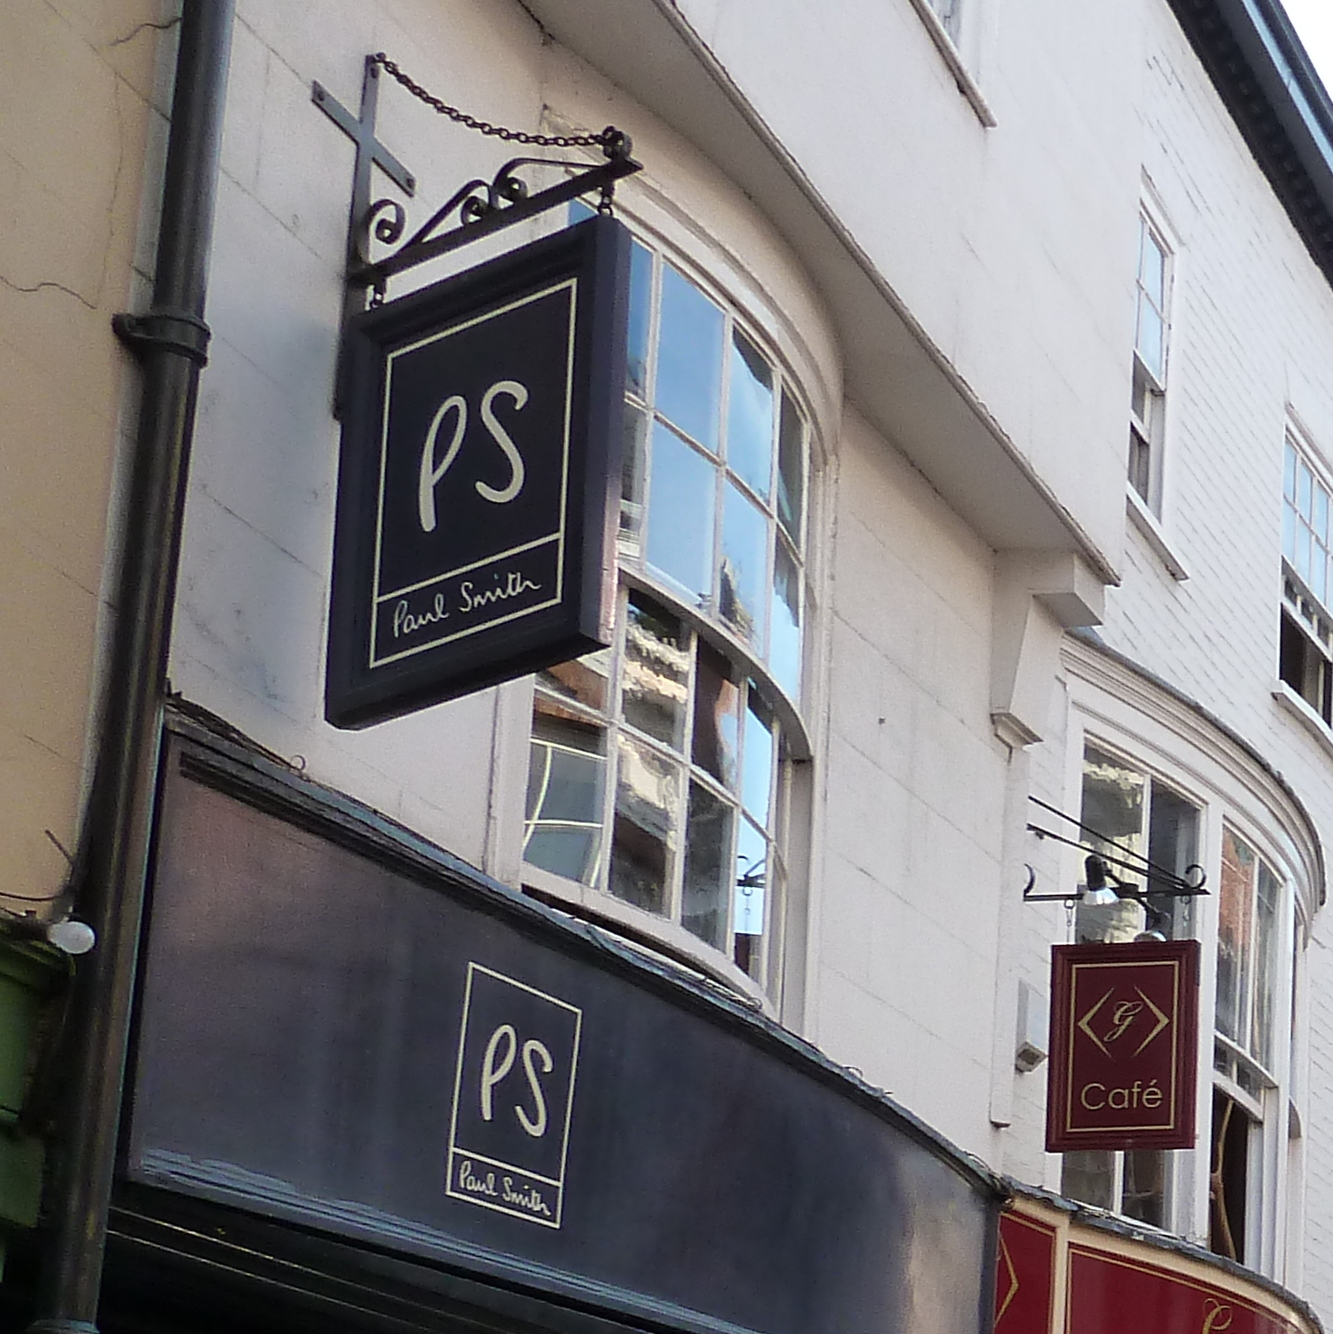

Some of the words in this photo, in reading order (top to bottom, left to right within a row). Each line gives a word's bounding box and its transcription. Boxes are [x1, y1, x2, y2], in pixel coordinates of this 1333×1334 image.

[419, 380, 528, 532] PS
[393, 593, 449, 637] Paul
[459, 572, 542, 612] Smith
[481, 1025, 553, 1137] PS
[1081, 1079, 1163, 1110] Café
[459, 1160, 499, 1196] Paul
[502, 1177, 551, 1216] Smith
